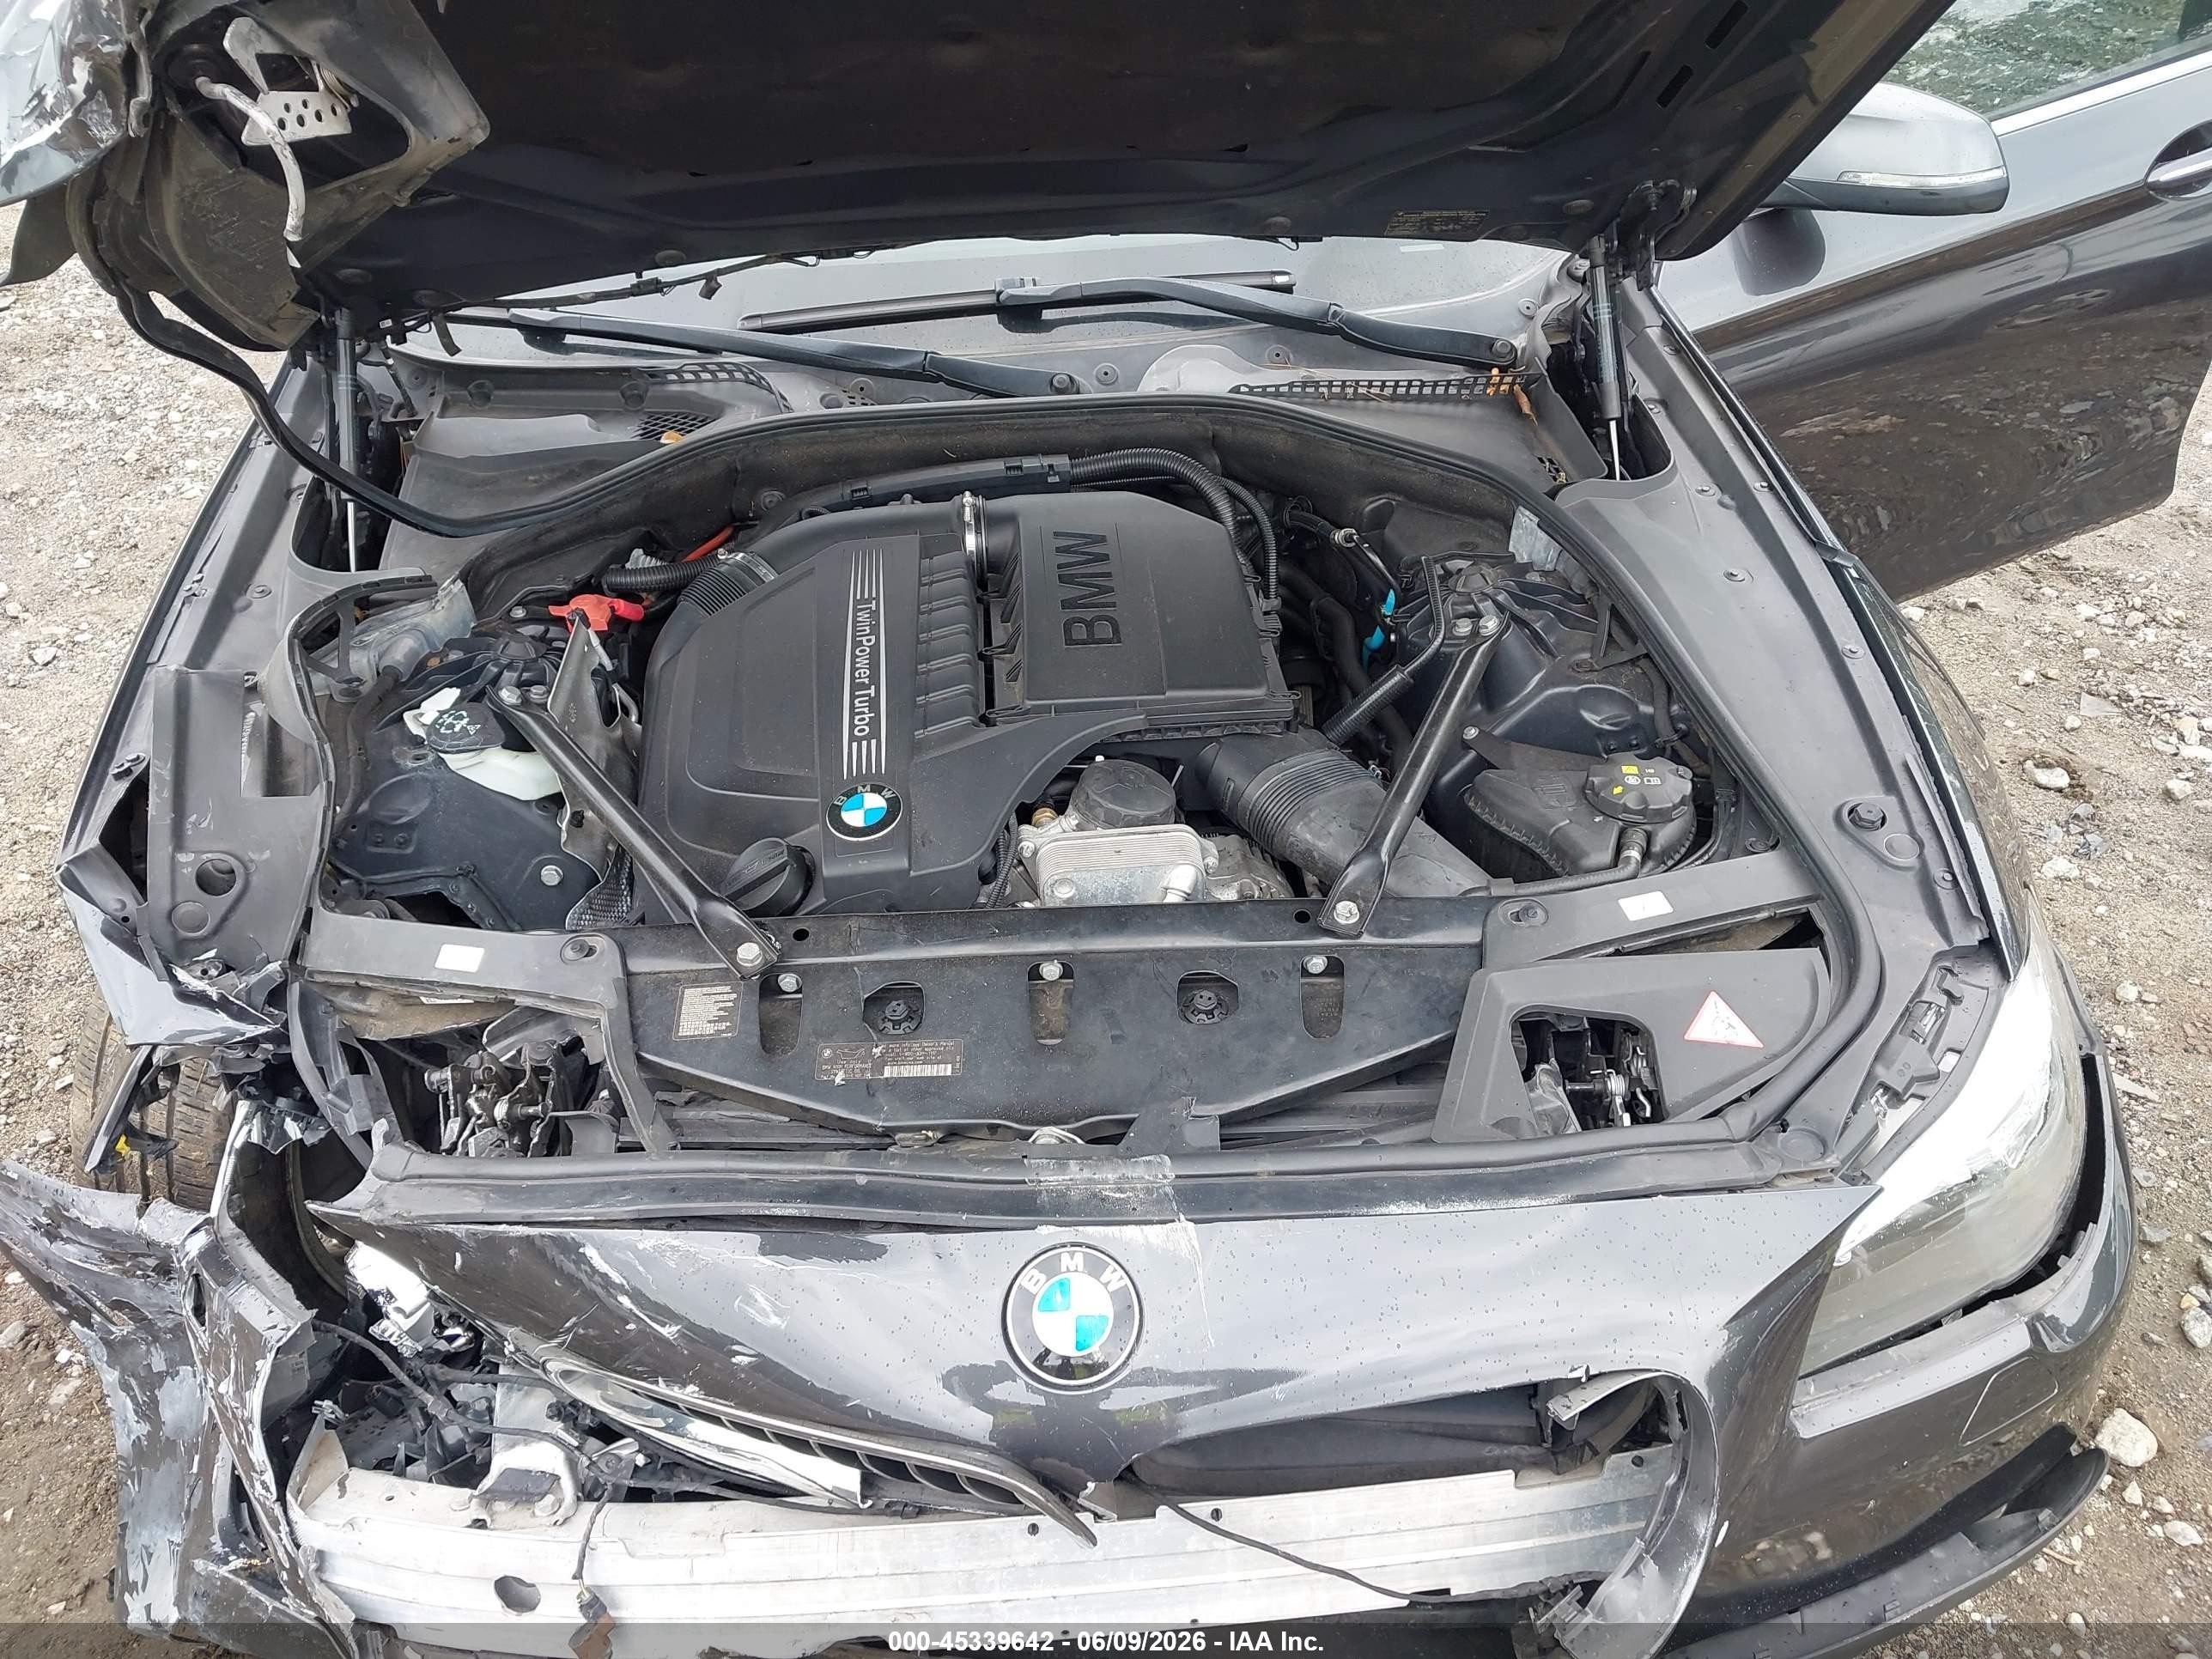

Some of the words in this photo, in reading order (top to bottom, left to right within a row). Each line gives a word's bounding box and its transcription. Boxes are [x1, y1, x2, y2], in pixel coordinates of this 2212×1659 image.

[1052, 530, 1123, 647] BMW
[854, 599, 876, 684] TwinPower
[854, 684, 875, 737] Turbo
[834, 784, 896, 806] BMW
[1020, 1252, 1127, 1294] BMW
